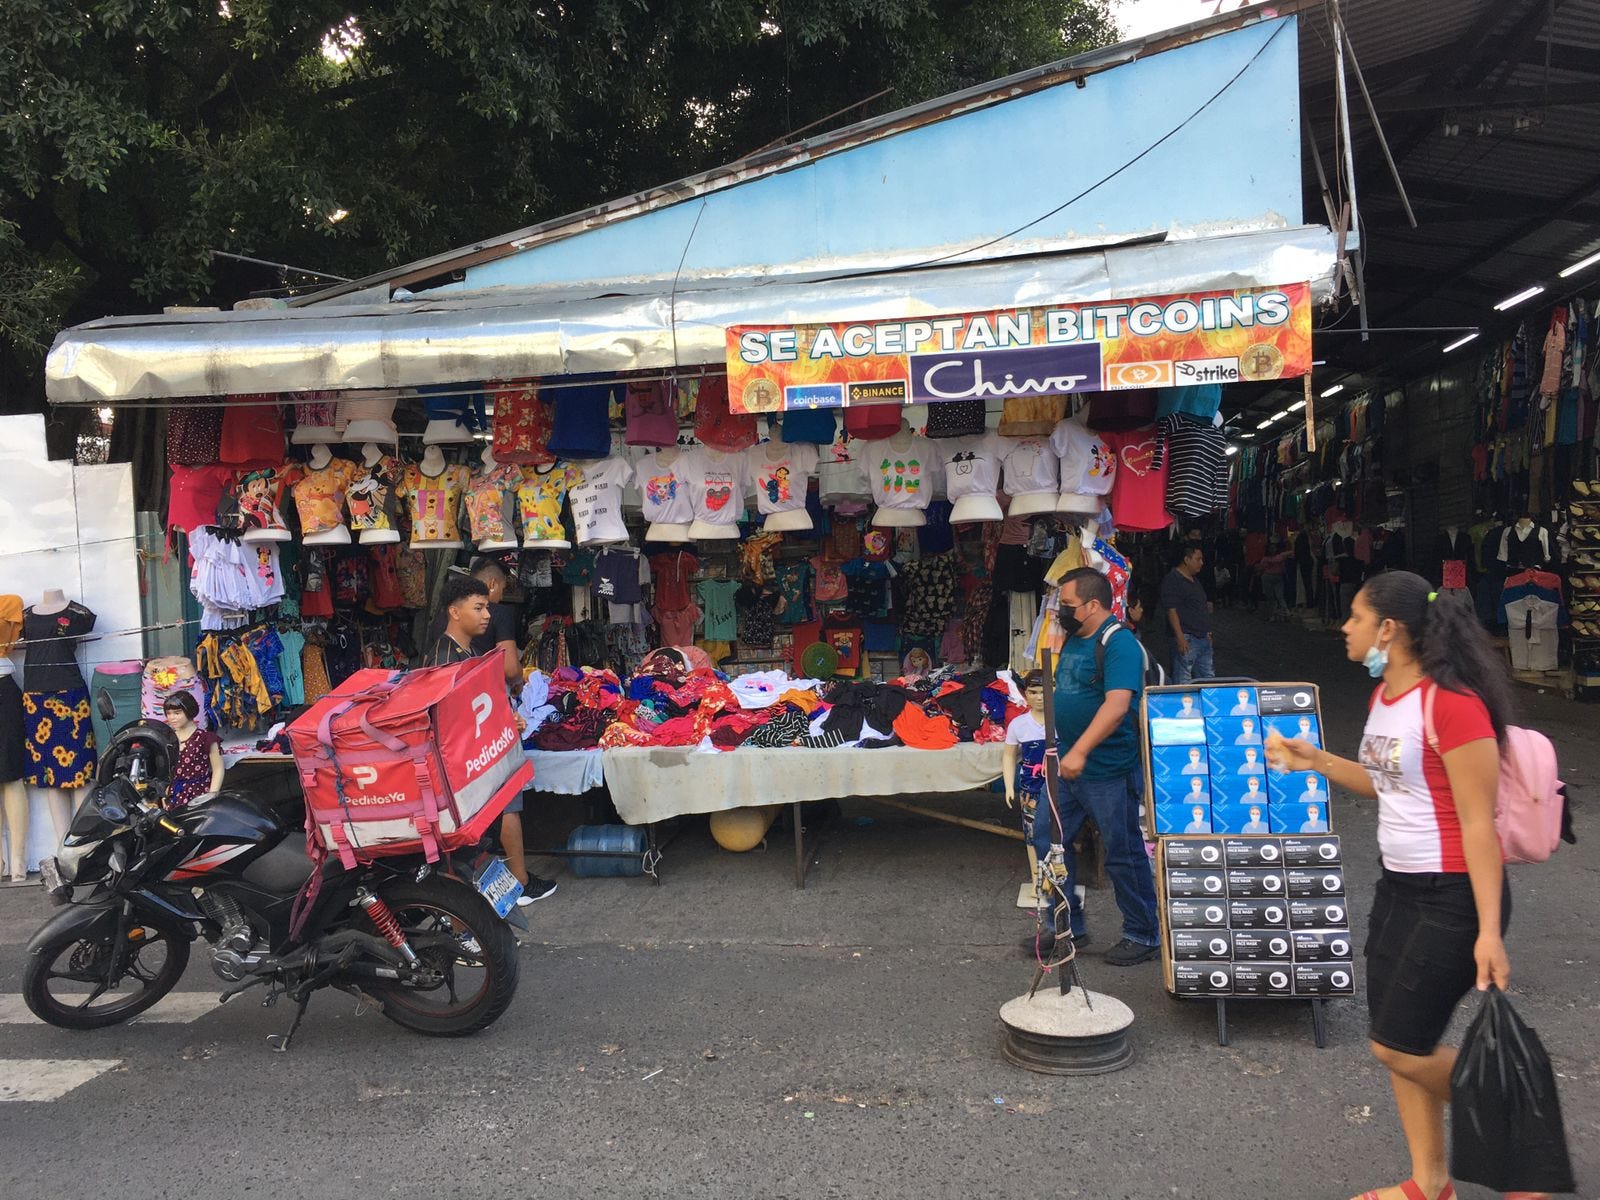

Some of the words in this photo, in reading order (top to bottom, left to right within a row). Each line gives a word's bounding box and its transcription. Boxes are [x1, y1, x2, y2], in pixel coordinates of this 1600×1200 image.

[740, 330, 798, 364] SE
[809, 311, 1031, 360] ACEPTAN
[1046, 293, 1290, 344] BITCOINS
[923, 359, 1087, 399] Chivo
[1195, 365, 1238, 382] strike
[793, 395, 836, 406] coinbase
[862, 387, 904, 398] BINANCE
[465, 726, 515, 778] PedidosYa
[344, 791, 406, 806] PedidosYa
